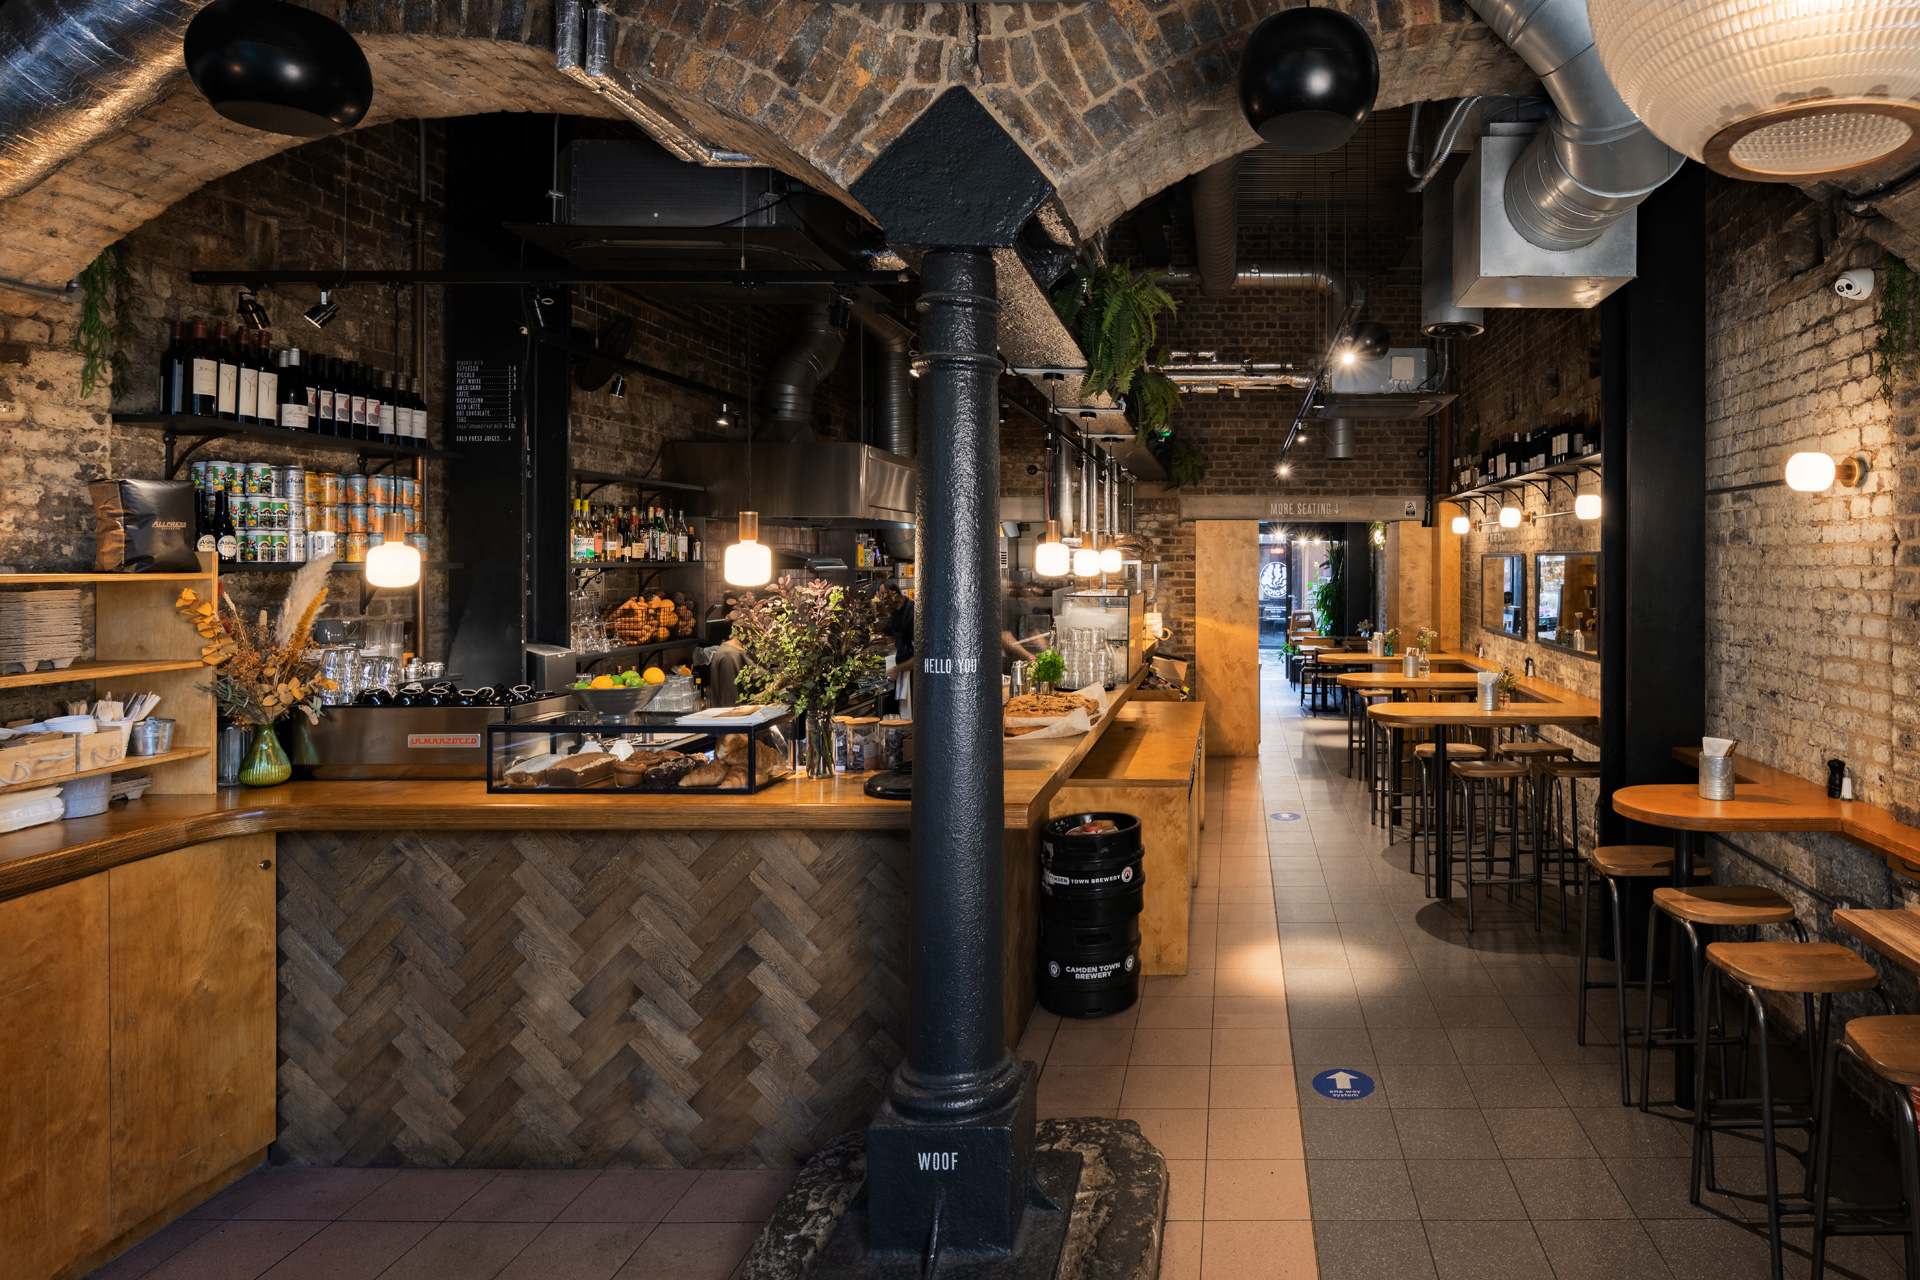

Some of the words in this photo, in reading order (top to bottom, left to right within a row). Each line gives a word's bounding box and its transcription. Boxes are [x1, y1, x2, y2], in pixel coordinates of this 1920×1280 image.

[1270, 503, 1293, 515] MORE
[1297, 503, 1331, 515] SEATING
[152, 520, 187, 528] ALLPRESS
[924, 658, 952, 674] HELLO
[958, 658, 977, 673] YOU
[1091, 874, 1120, 884] BREWERY
[1099, 962, 1121, 972] TOWN
[1075, 971, 1112, 980] BREWERY
[917, 1152, 959, 1170] WOOF
